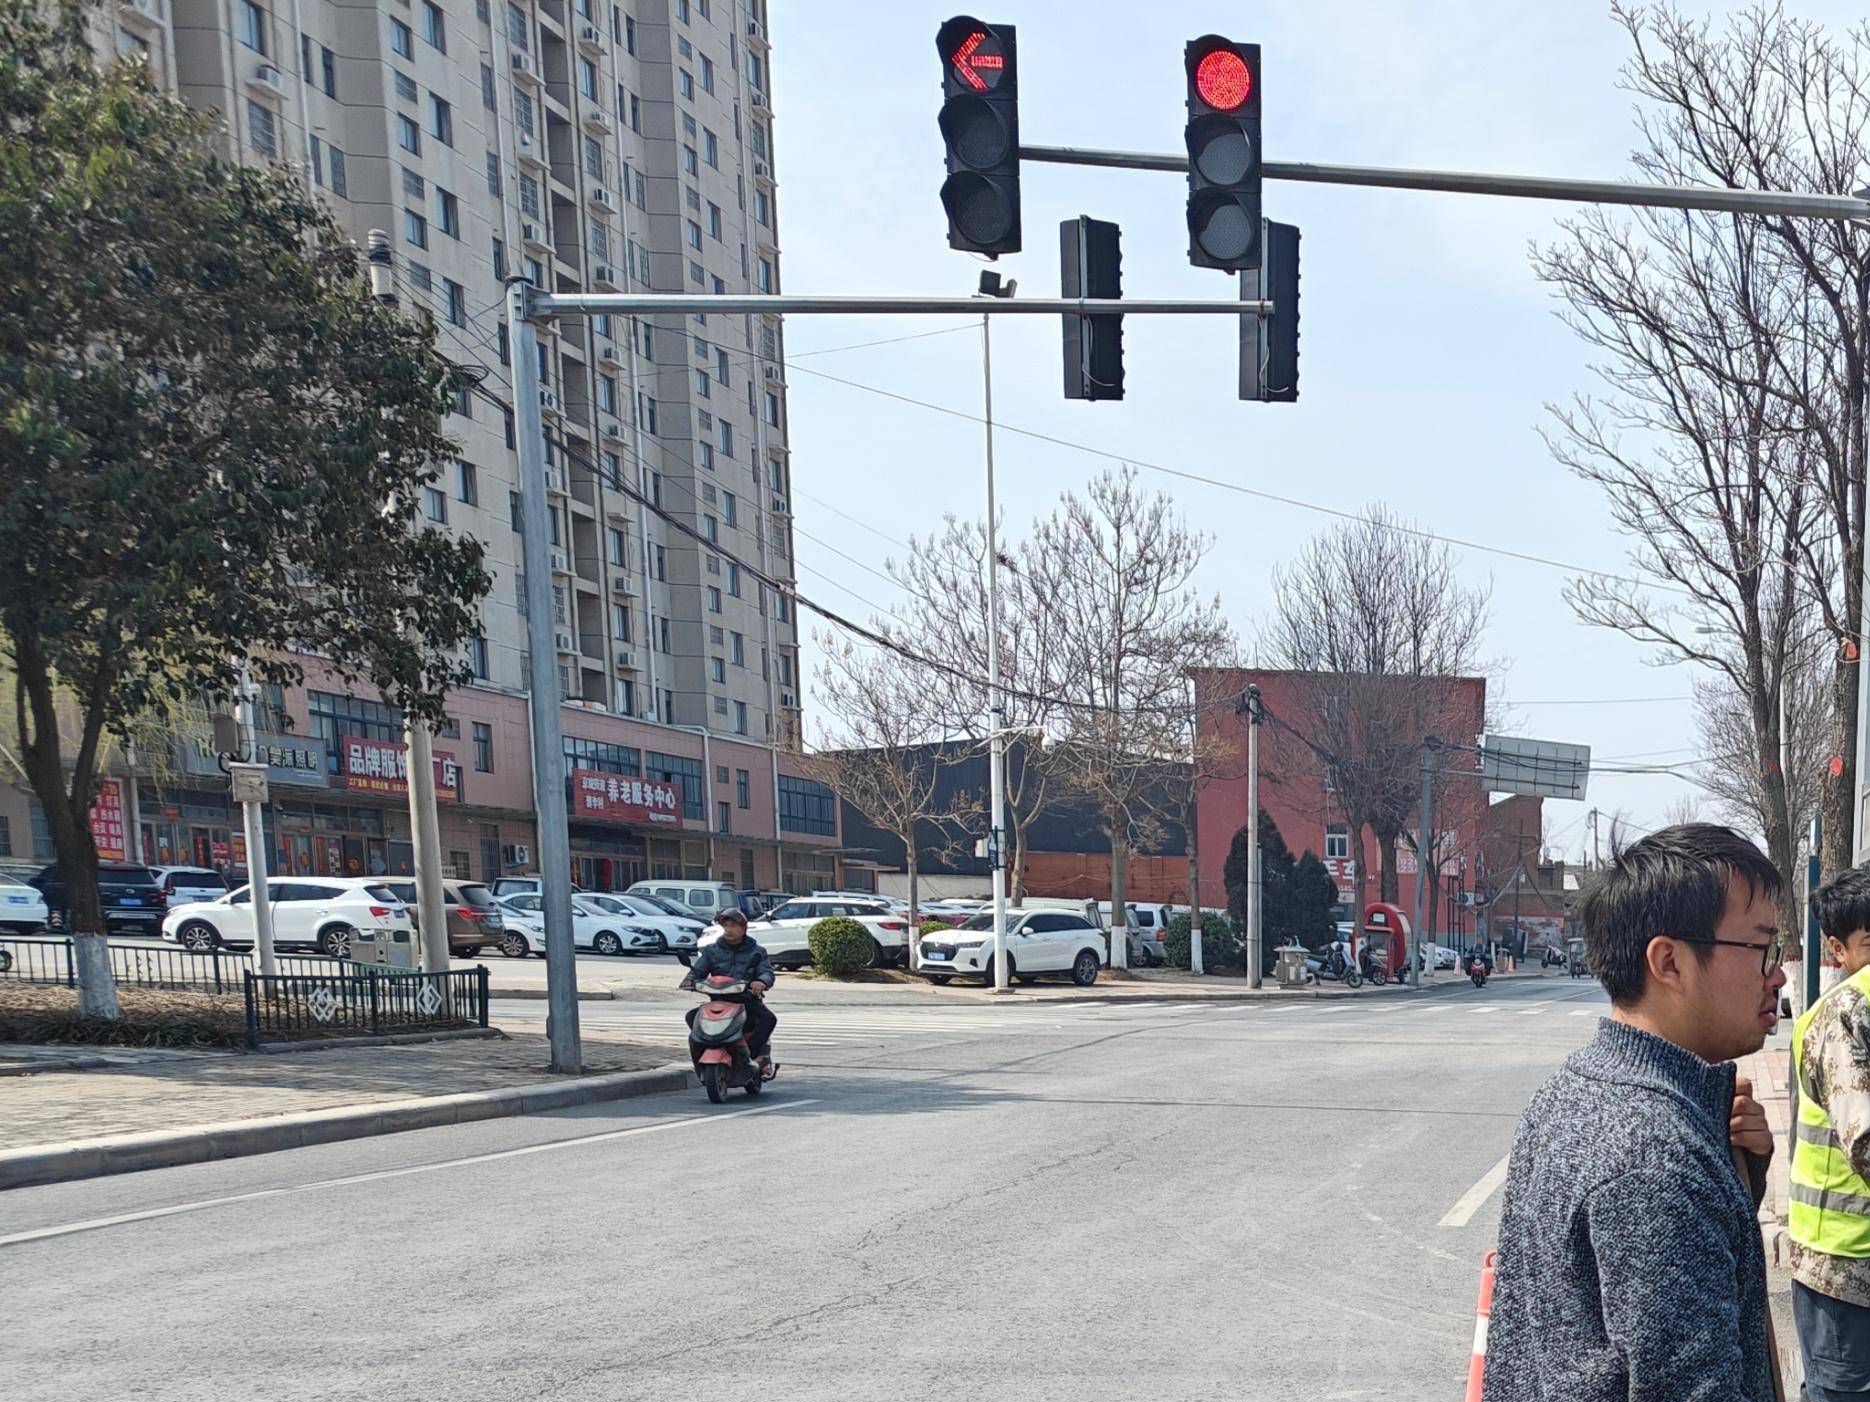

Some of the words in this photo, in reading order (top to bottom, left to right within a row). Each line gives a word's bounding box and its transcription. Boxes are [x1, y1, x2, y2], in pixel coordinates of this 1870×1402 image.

[607, 777, 676, 810] 养老服务中心
